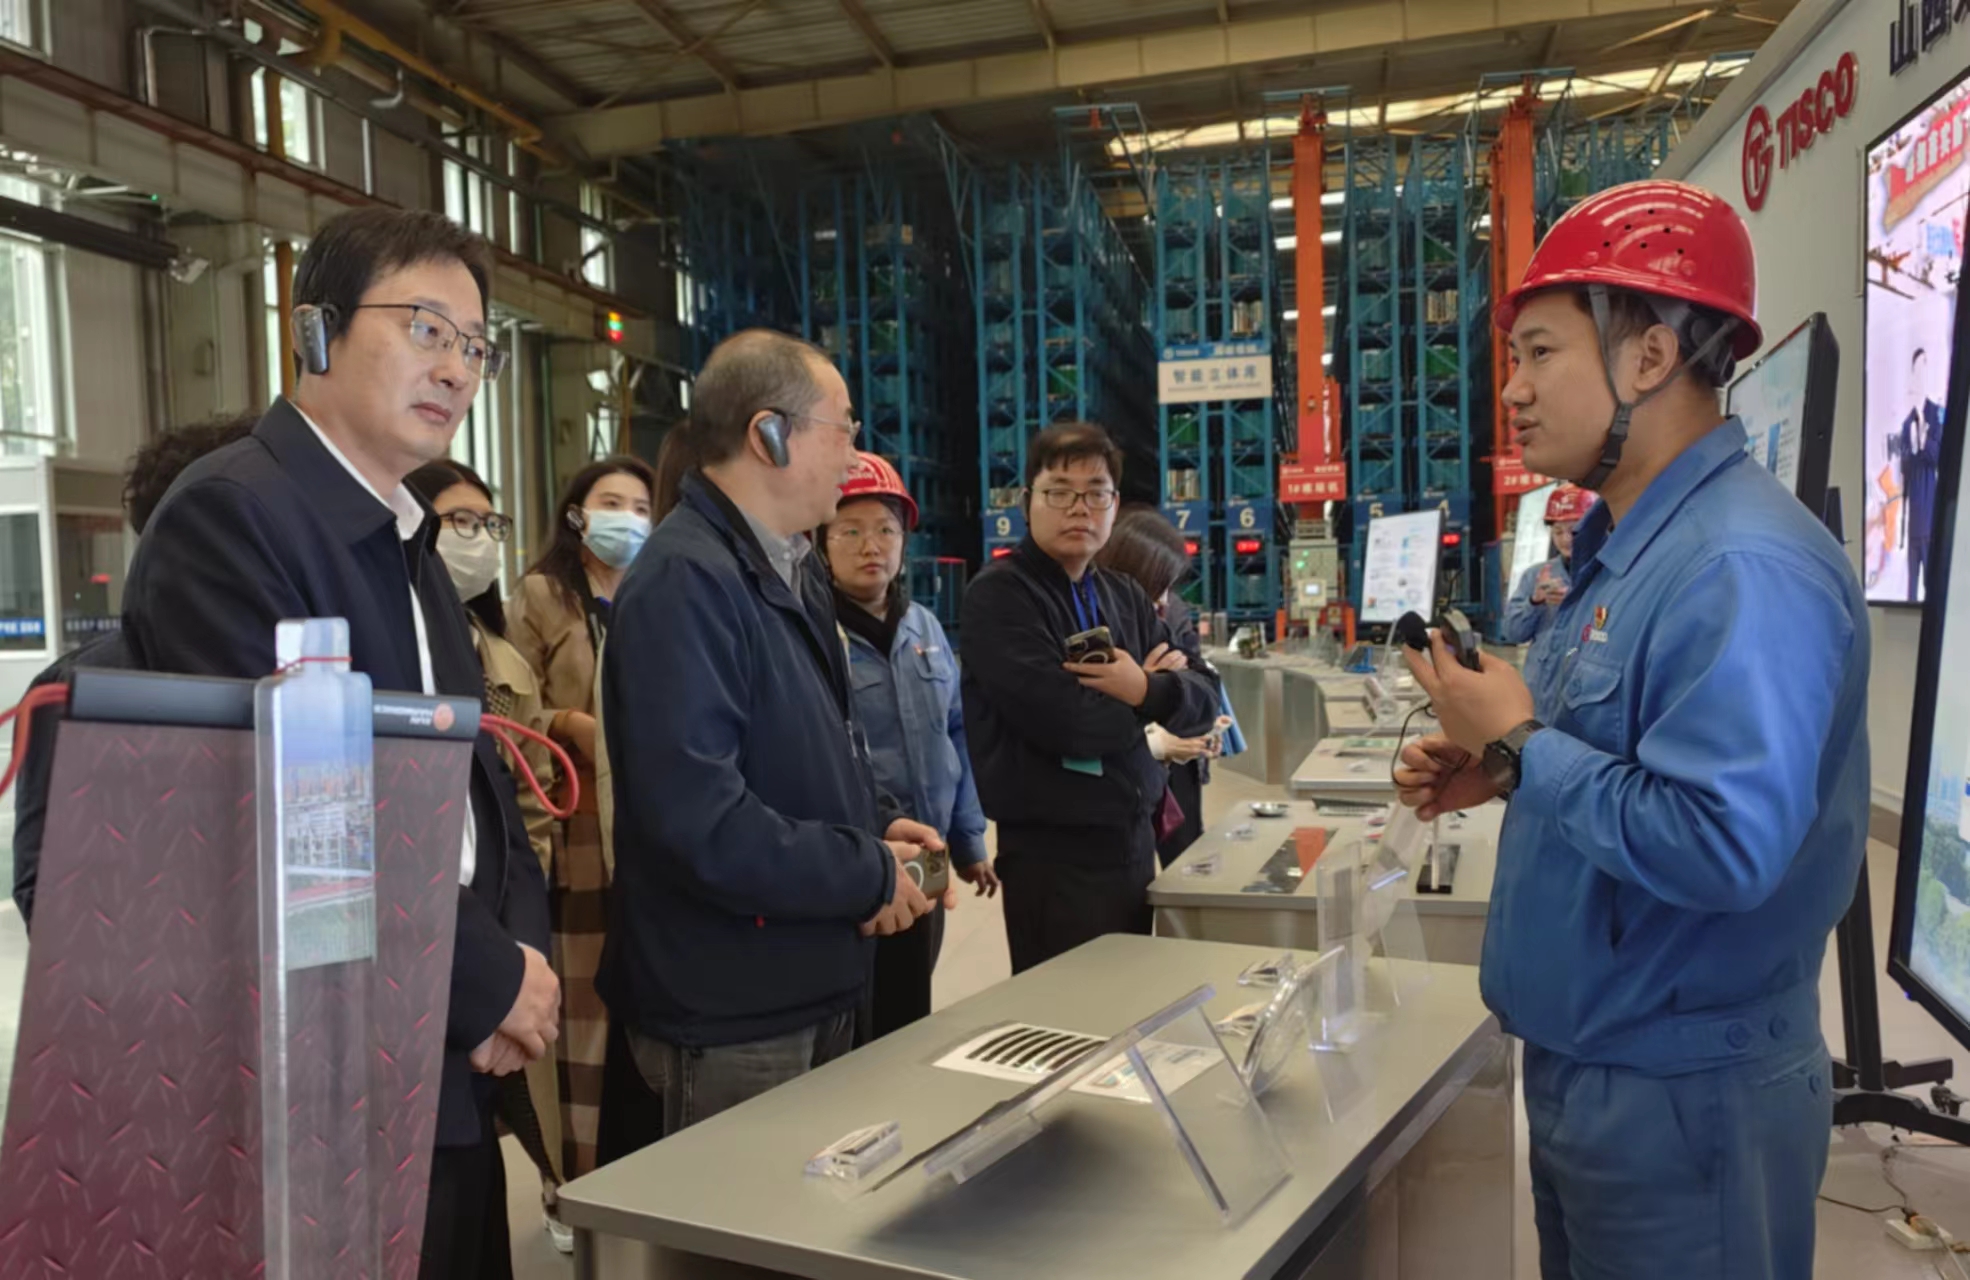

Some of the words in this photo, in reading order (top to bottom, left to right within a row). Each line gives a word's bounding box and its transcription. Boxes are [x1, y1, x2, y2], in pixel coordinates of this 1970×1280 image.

[1889, 0, 1970, 77] 山西
[1775, 51, 1858, 170] TISCO
[996, 516, 1012, 537] 9
[1175, 510, 1192, 529] 7
[1239, 507, 1256, 528] 6
